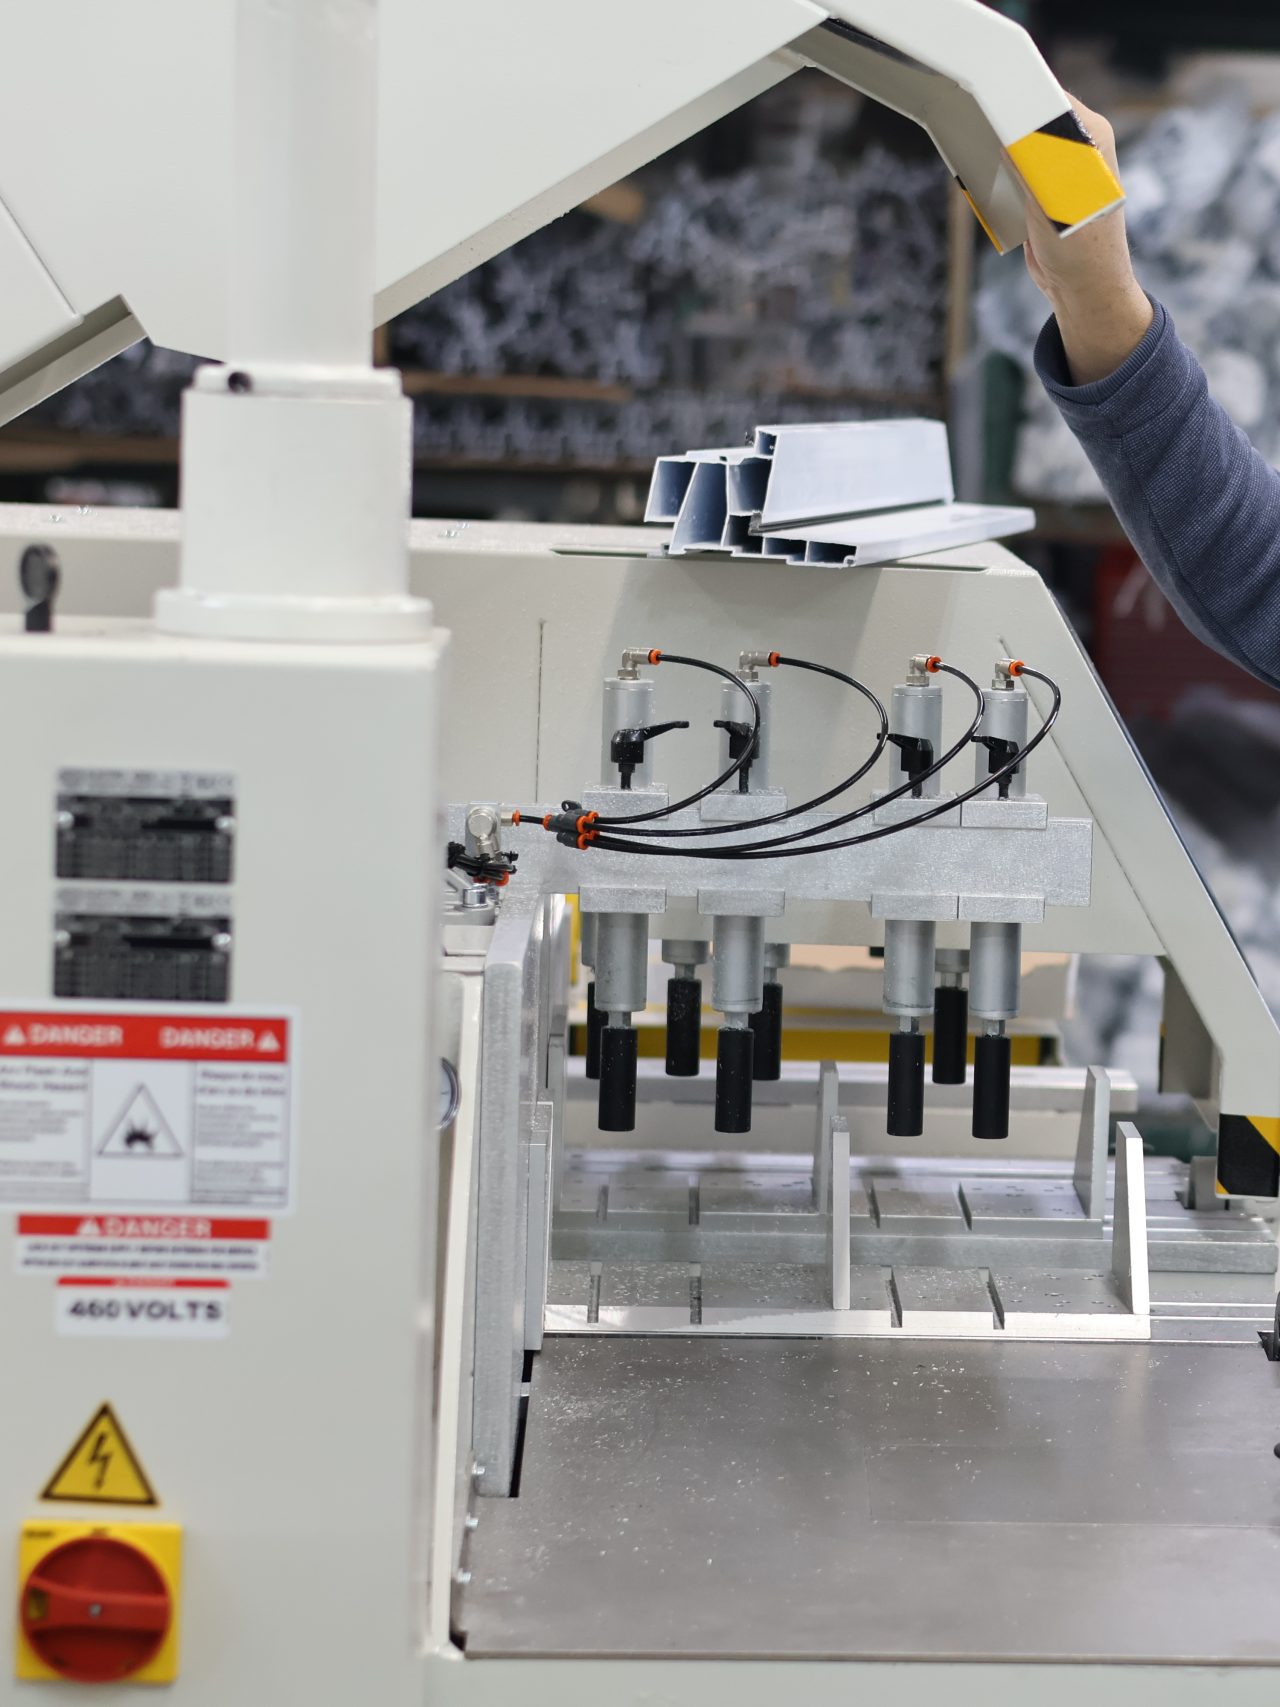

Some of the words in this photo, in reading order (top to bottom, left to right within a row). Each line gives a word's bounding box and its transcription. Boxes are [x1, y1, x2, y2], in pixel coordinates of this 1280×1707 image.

[28, 1023, 124, 1046] DANGER
[158, 1025, 255, 1050] DANGER
[105, 1217, 212, 1238] DANGER
[69, 1299, 120, 1319] 460
[127, 1300, 221, 1320] VOLTS
